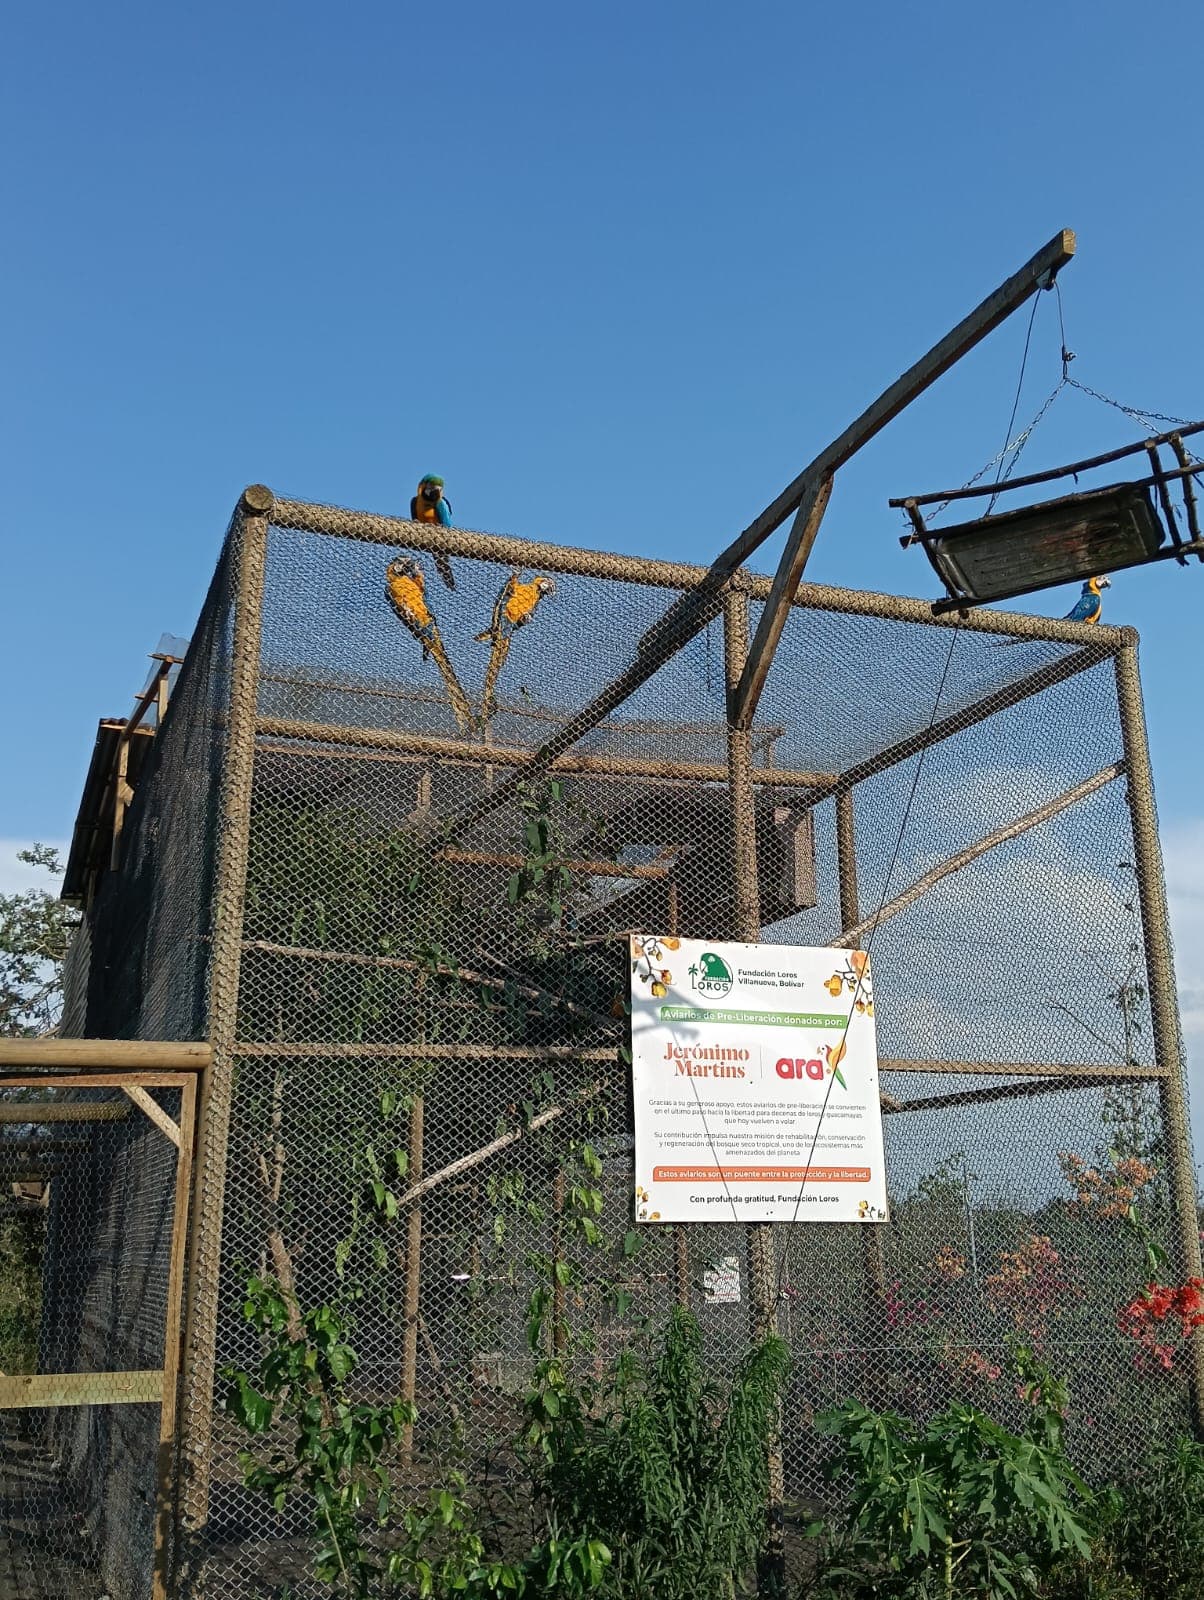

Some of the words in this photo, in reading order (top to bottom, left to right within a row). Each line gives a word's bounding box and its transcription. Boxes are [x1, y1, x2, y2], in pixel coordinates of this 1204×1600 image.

[738, 969, 775, 978] Fundación
[692, 980, 729, 992] LOROS
[738, 978, 778, 987] Villanueva,
[664, 1009, 701, 1019] Aviarios
[704, 1011, 715, 1020] de
[718, 1012, 782, 1023] Pre-Liberación
[784, 1015, 822, 1025] donados
[824, 1018, 842, 1027] por:
[664, 1042, 750, 1061] Jerónimo
[674, 1060, 746, 1078] Martins
[776, 1058, 824, 1080] ara
[659, 1170, 678, 1178] Estos
[680, 1170, 706, 1178] aviarios
[734, 1170, 760, 1180] puente
[690, 1195, 704, 1203] Con
[707, 1194, 742, 1204] profunda
[744, 1194, 776, 1204] gratitud,
